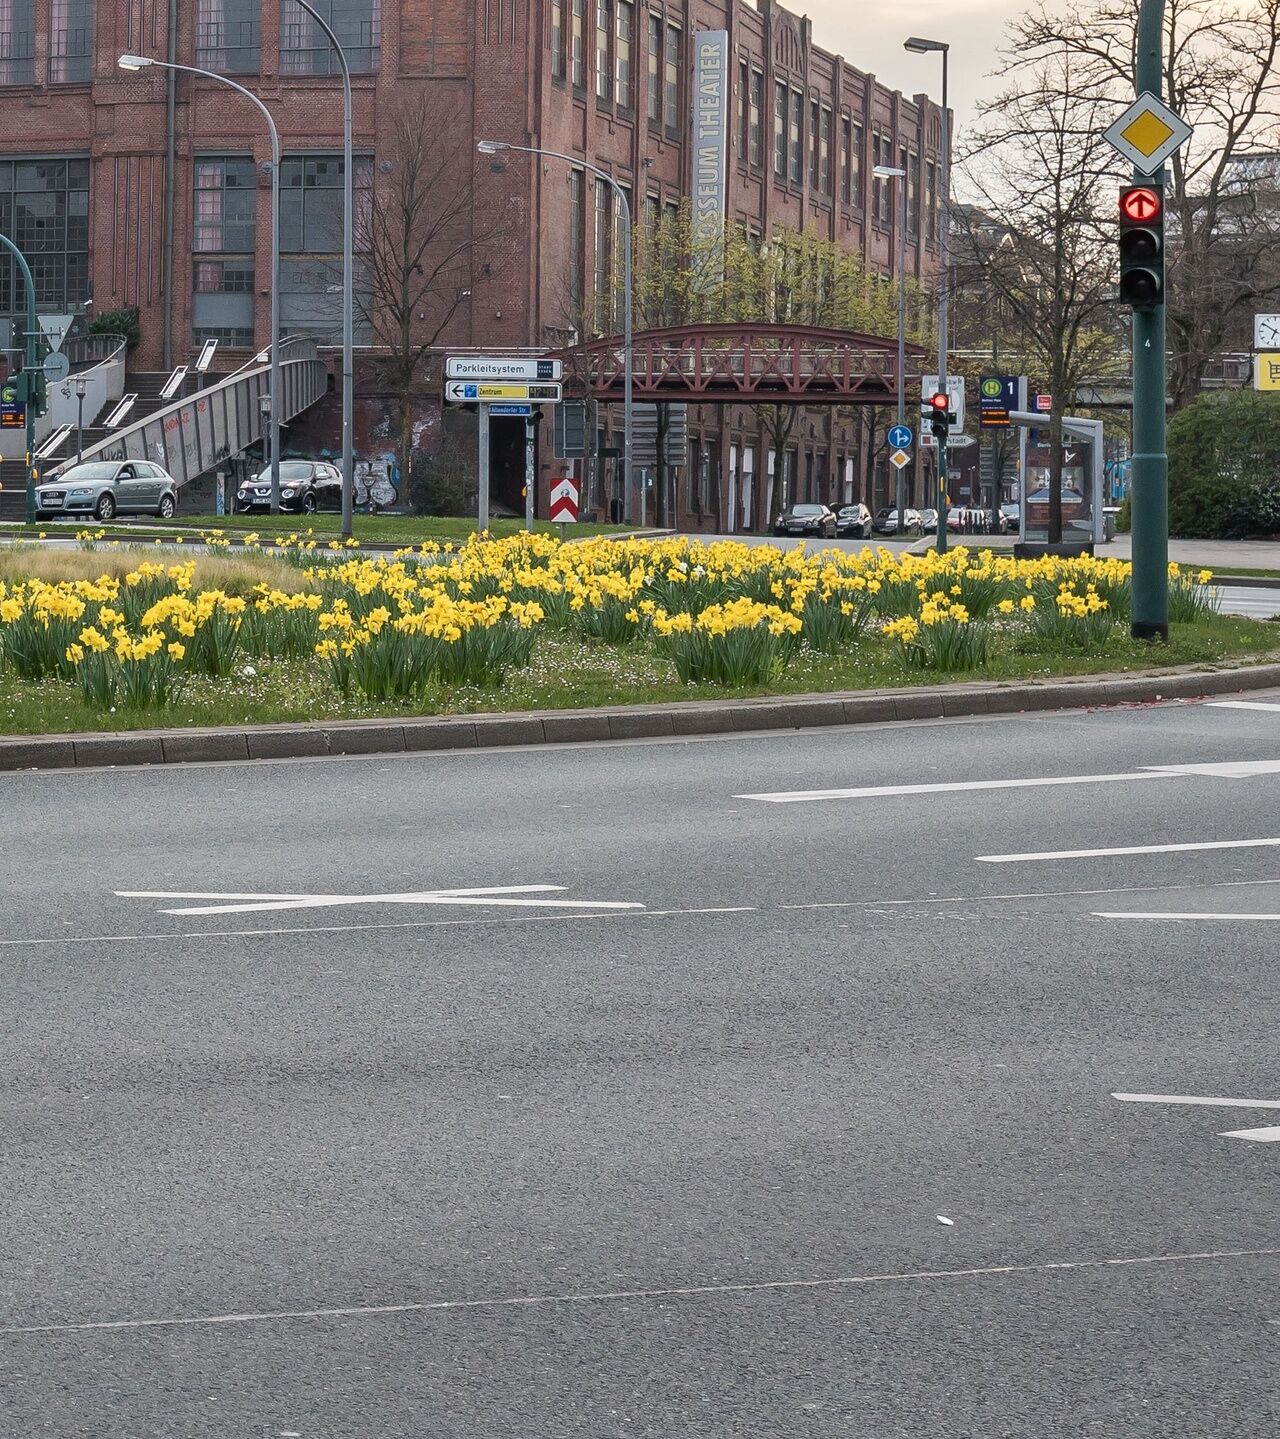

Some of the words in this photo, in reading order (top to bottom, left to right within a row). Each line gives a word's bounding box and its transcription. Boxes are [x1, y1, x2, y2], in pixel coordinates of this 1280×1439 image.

[699, 42, 722, 139] THEATER
[696, 145, 720, 257] OSSEUM
[456, 363, 525, 375] Parkleitsystem
[479, 387, 503, 396] Zentrum
[1007, 381, 1014, 395] 1
